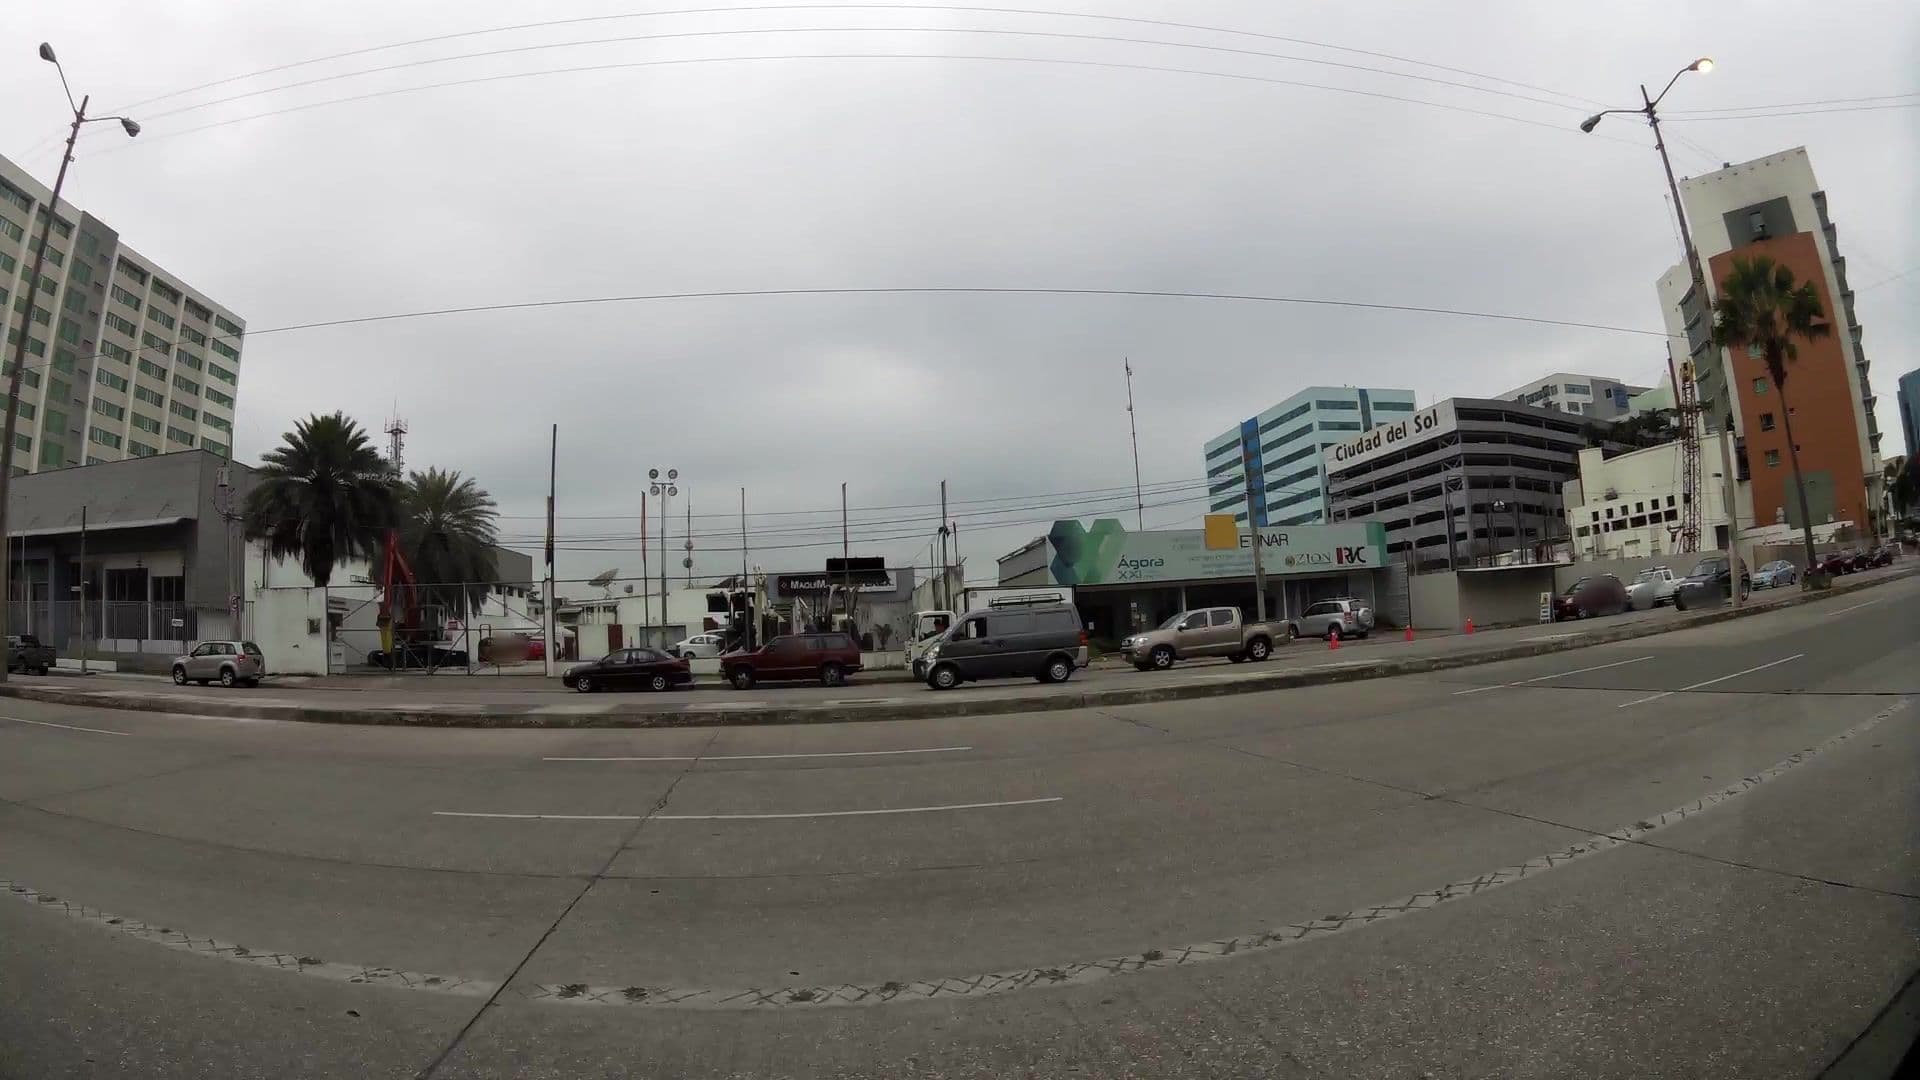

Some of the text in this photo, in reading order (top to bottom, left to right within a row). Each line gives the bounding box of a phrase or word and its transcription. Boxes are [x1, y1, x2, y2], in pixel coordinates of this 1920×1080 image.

[1336, 409, 1439, 461] Ciudad del Sol
[1239, 533, 1289, 548] ENAR
[1117, 554, 1165, 570] Ágora
[1296, 552, 1331, 565] ZION
